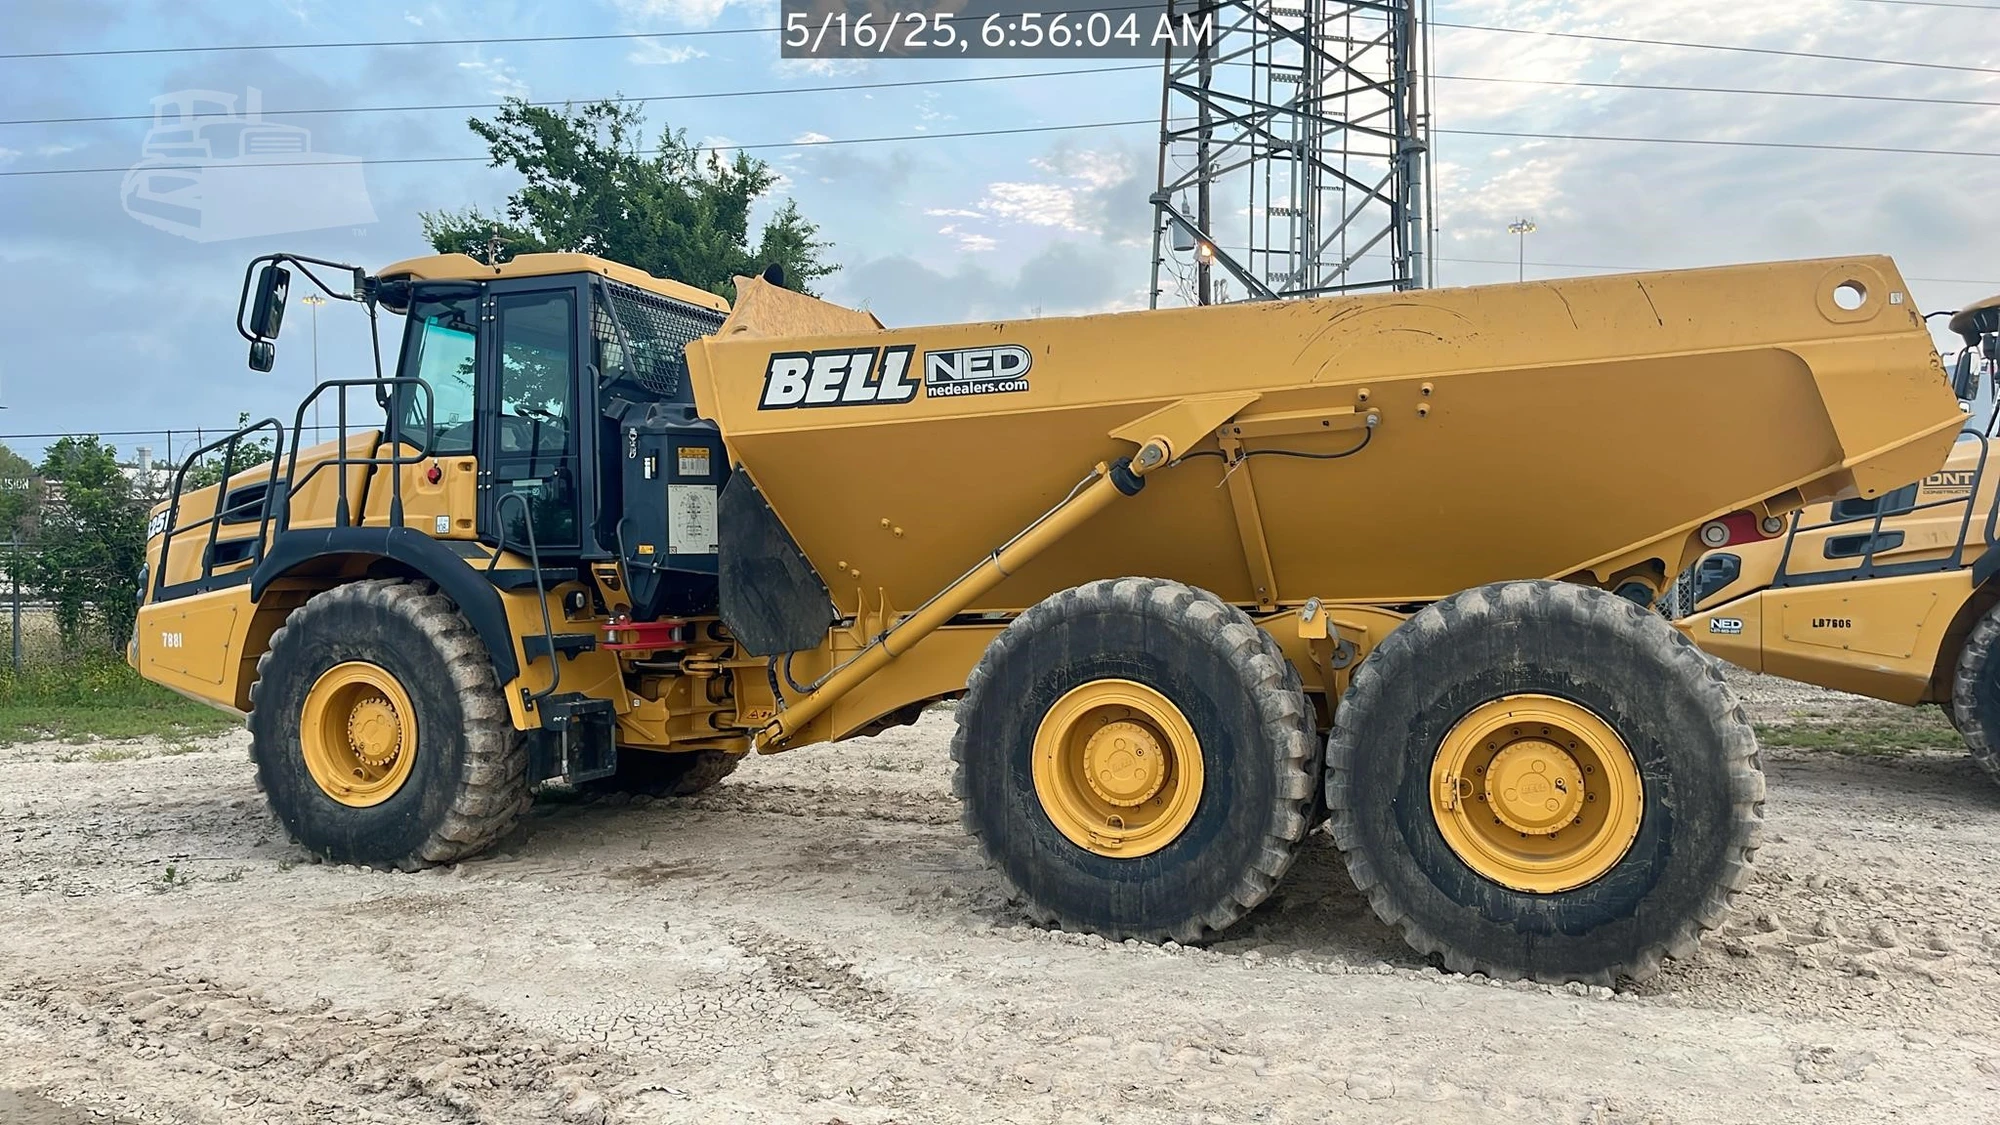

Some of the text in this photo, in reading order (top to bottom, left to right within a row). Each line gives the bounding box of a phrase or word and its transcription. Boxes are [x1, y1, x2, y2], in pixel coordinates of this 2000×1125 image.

[927, 347, 1030, 383] NED
[762, 349, 916, 407] BELL
[928, 380, 1028, 397] nedealers.com
[1710, 618, 1742, 629] NED
[162, 632, 182, 648] 7881
